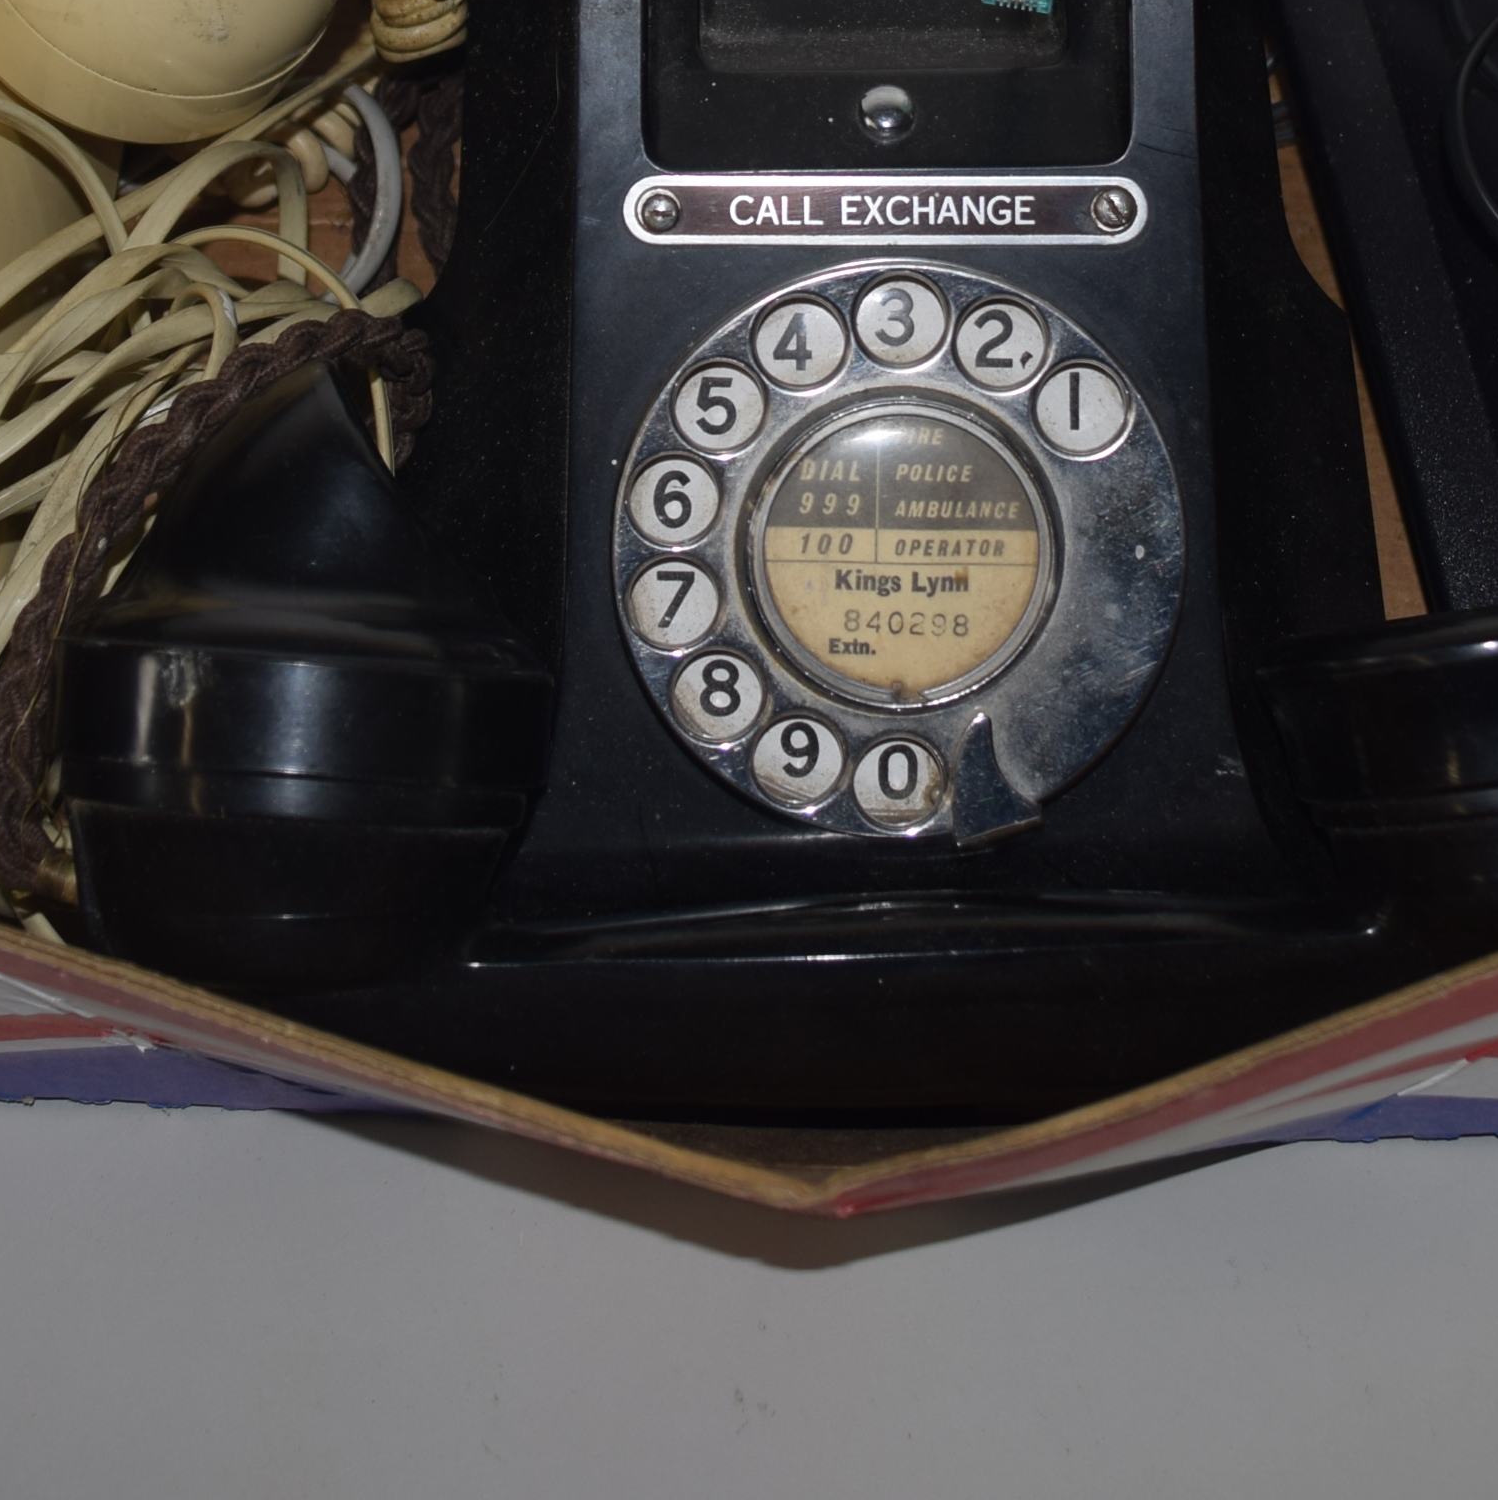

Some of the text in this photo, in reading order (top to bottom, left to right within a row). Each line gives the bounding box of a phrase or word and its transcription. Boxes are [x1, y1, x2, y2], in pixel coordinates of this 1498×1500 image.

[728, 194, 1036, 227] CALL EXCHANGE
[874, 288, 914, 347] 3
[974, 309, 1014, 369] 2
[773, 312, 813, 371] 4
[695, 376, 738, 435] 5
[1068, 371, 1081, 431] 1
[799, 459, 861, 481] DIAL
[895, 463, 973, 483] POLICE
[653, 470, 693, 529] 6
[799, 492, 861, 516] 999
[895, 500, 1020, 520] AMBULANCE
[800, 532, 854, 555] 100
[895, 539, 1005, 557] OPERATOR
[656, 570, 696, 629] 7
[834, 569, 970, 597] Kings Lynn
[843, 609, 970, 637] 840298
[828, 637, 877, 656] Extn.
[701, 659, 742, 717] 8
[780, 722, 820, 779] 9
[878, 744, 919, 800] 0
